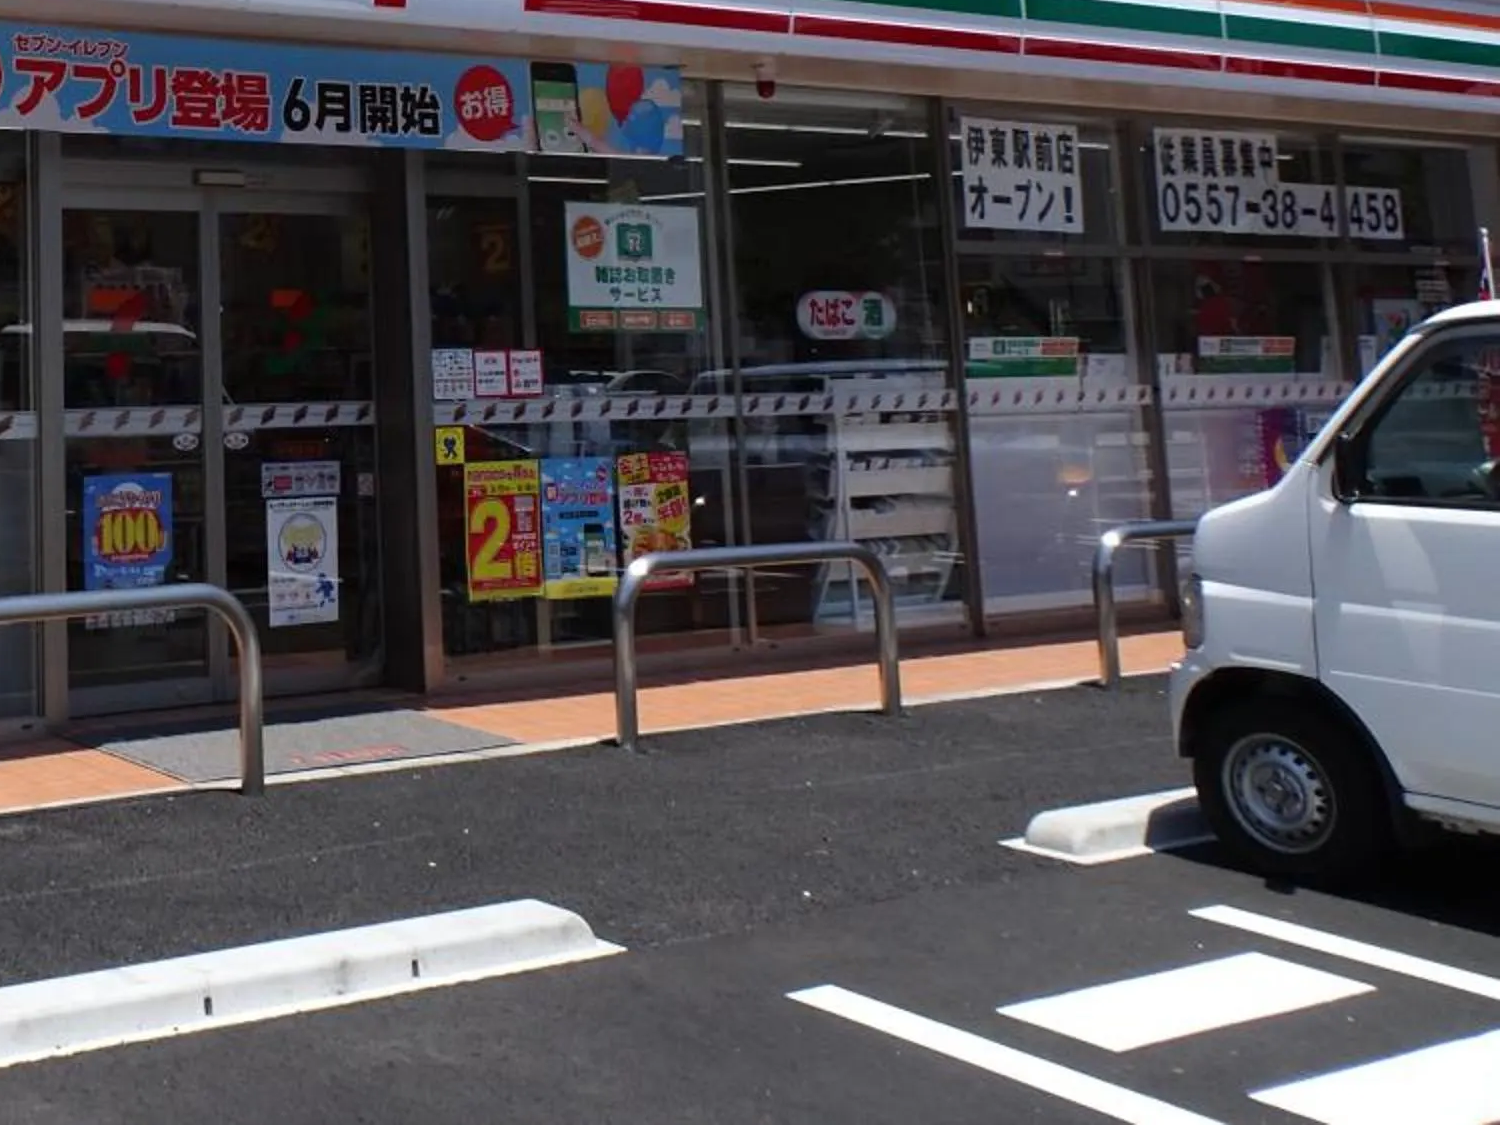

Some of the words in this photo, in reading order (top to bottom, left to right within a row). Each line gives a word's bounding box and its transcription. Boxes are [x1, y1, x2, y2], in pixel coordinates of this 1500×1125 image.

[15, 58, 270, 133] アプリ登場
[282, 76, 441, 136] 6月開始
[459, 84, 510, 122] お得
[966, 126, 1075, 175] 伊東駅前店
[1159, 134, 1274, 181] 従業員募集中
[609, 286, 662, 303] サービス
[809, 298, 855, 327] たばこ
[470, 497, 513, 580] 2
